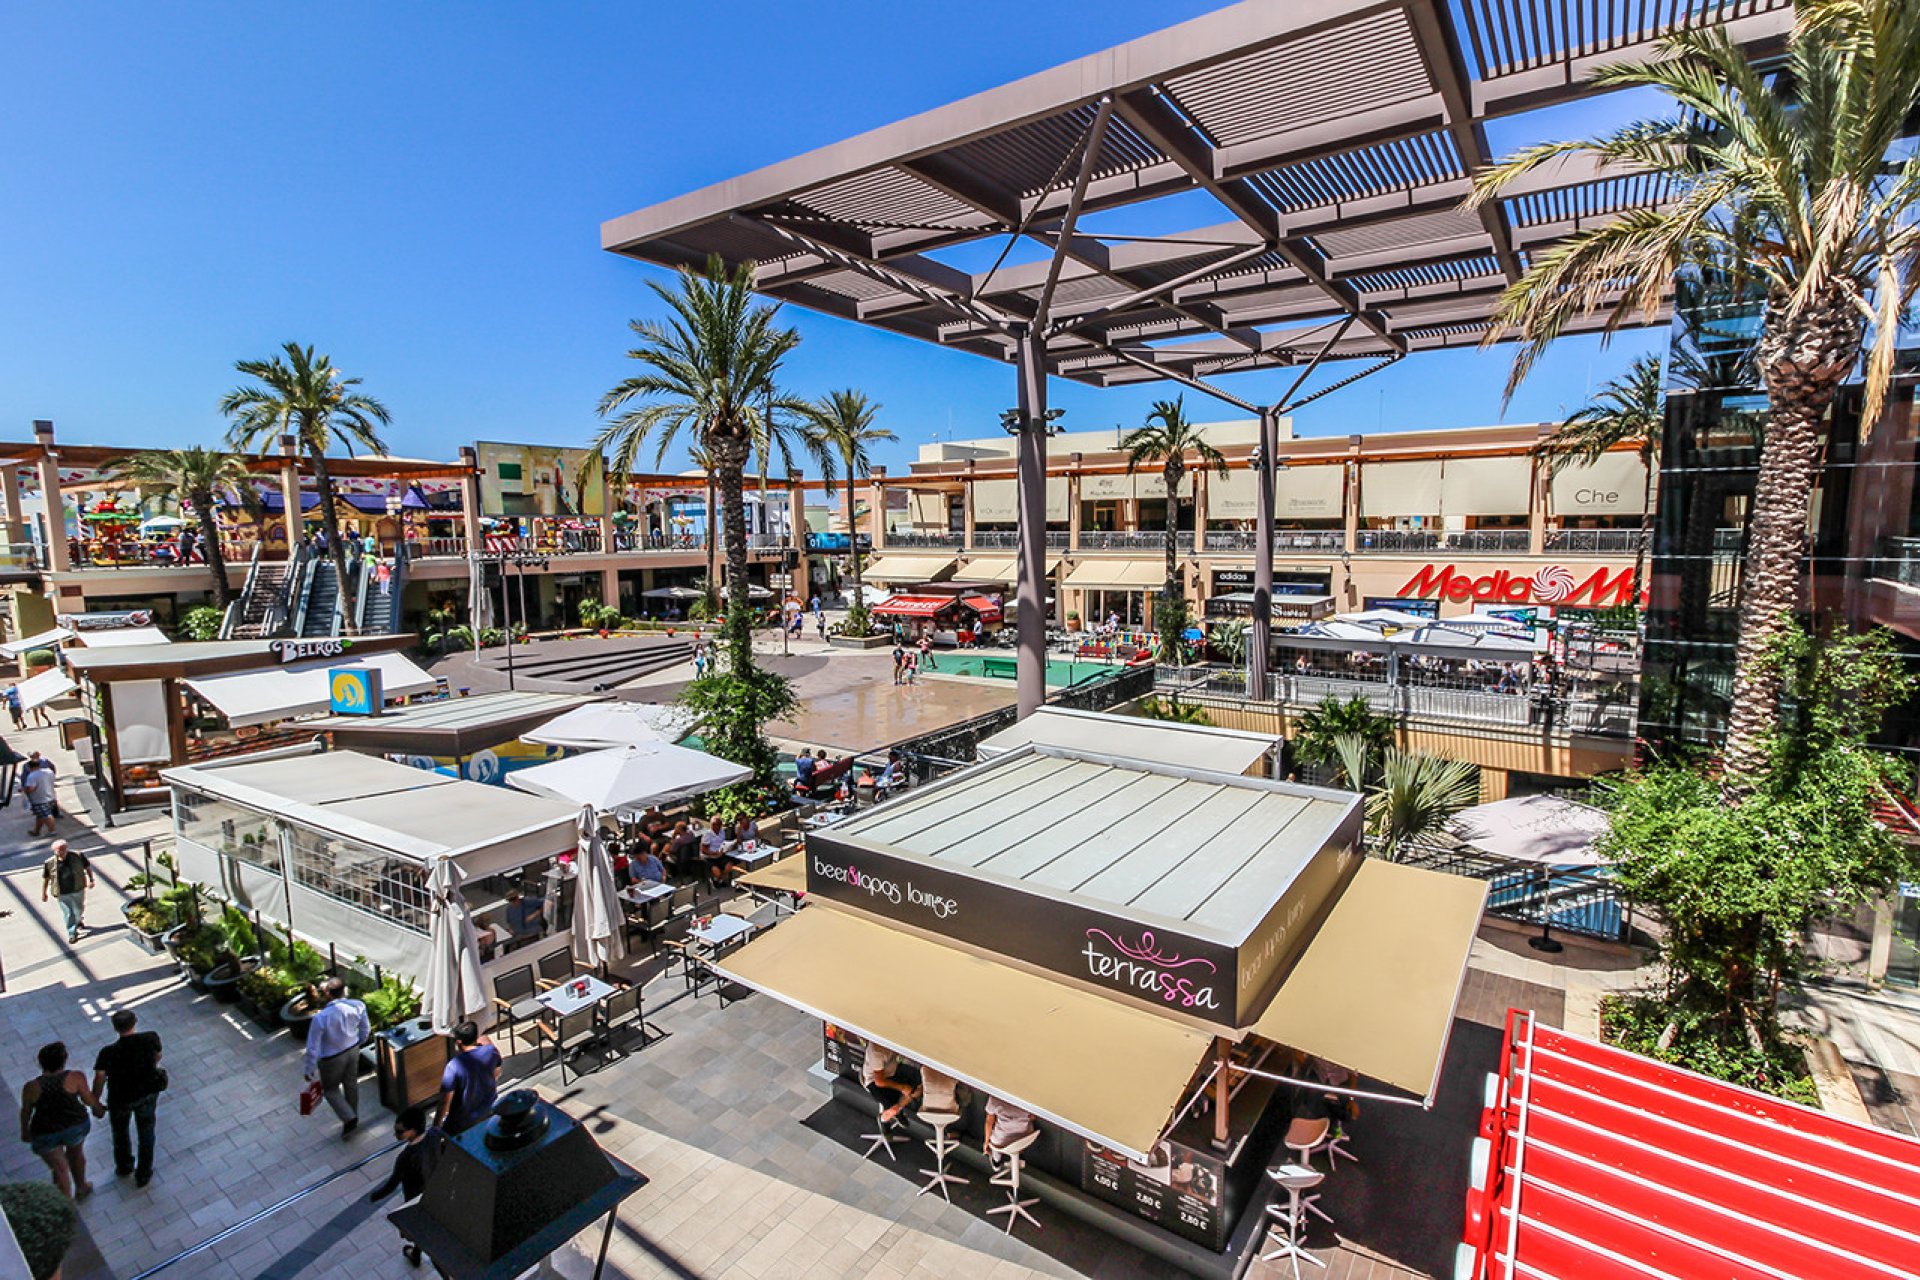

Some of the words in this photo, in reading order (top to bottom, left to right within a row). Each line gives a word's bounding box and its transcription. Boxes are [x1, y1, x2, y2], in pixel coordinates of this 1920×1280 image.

[1575, 488, 1619, 504] Che
[1219, 572, 1248, 580] adidas
[1396, 564, 1534, 602] Media
[271, 641, 343, 662] BELROS
[907, 882, 958, 918] lounge
[1081, 941, 1219, 1009] terrassa
